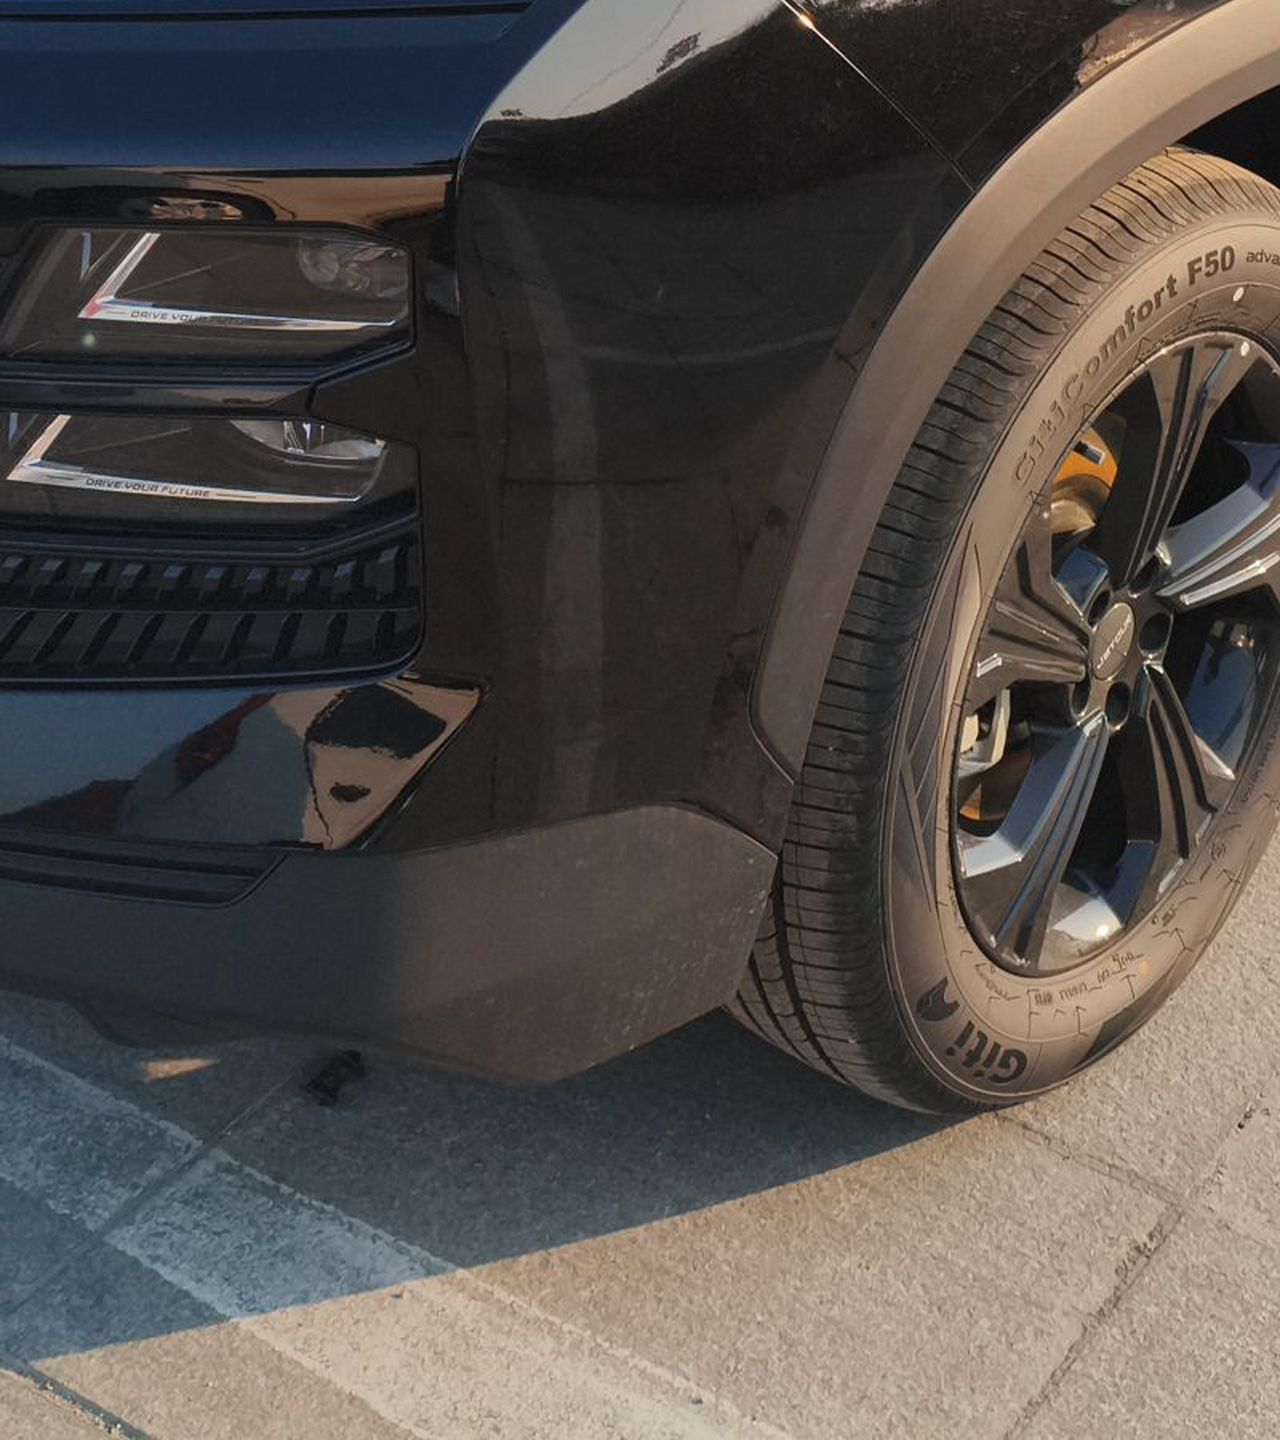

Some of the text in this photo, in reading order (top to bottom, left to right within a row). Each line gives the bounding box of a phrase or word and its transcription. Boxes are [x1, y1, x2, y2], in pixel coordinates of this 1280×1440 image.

[130, 309, 169, 322] DRIVE
[1014, 272, 1178, 483] GitiComfort
[1186, 245, 1237, 286] F50
[85, 476, 211, 498] DRIVE YOUR FUTURE
[945, 1021, 1028, 1084] Giti
